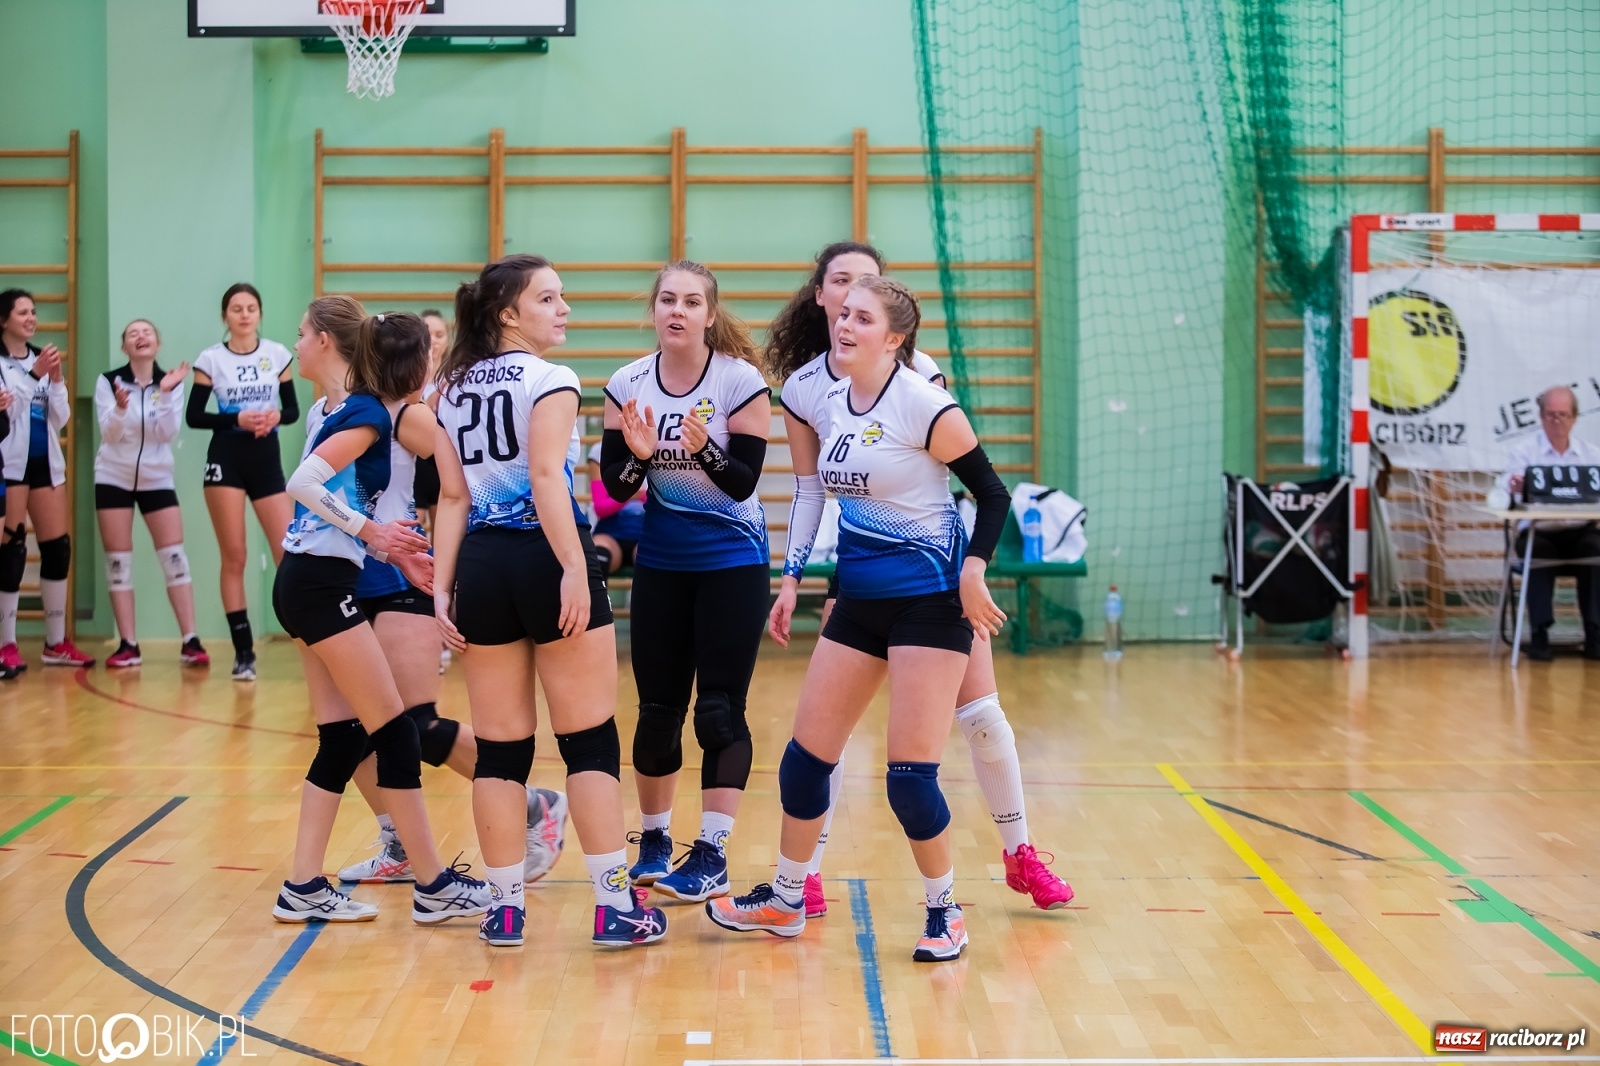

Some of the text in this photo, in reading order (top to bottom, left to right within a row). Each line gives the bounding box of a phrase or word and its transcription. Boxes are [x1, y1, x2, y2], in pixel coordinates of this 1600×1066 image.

[236, 365, 259, 382] 23
[241, 385, 274, 396] VOLLEY
[456, 389, 520, 465] 20
[657, 413, 685, 441] 12
[652, 448, 698, 461] VOLL
[826, 433, 856, 463] 16
[650, 461, 704, 471] APKOWIC
[821, 470, 870, 488] VOLLEY
[1532, 467, 1546, 490] 3
[1270, 491, 1329, 511] RLPS
